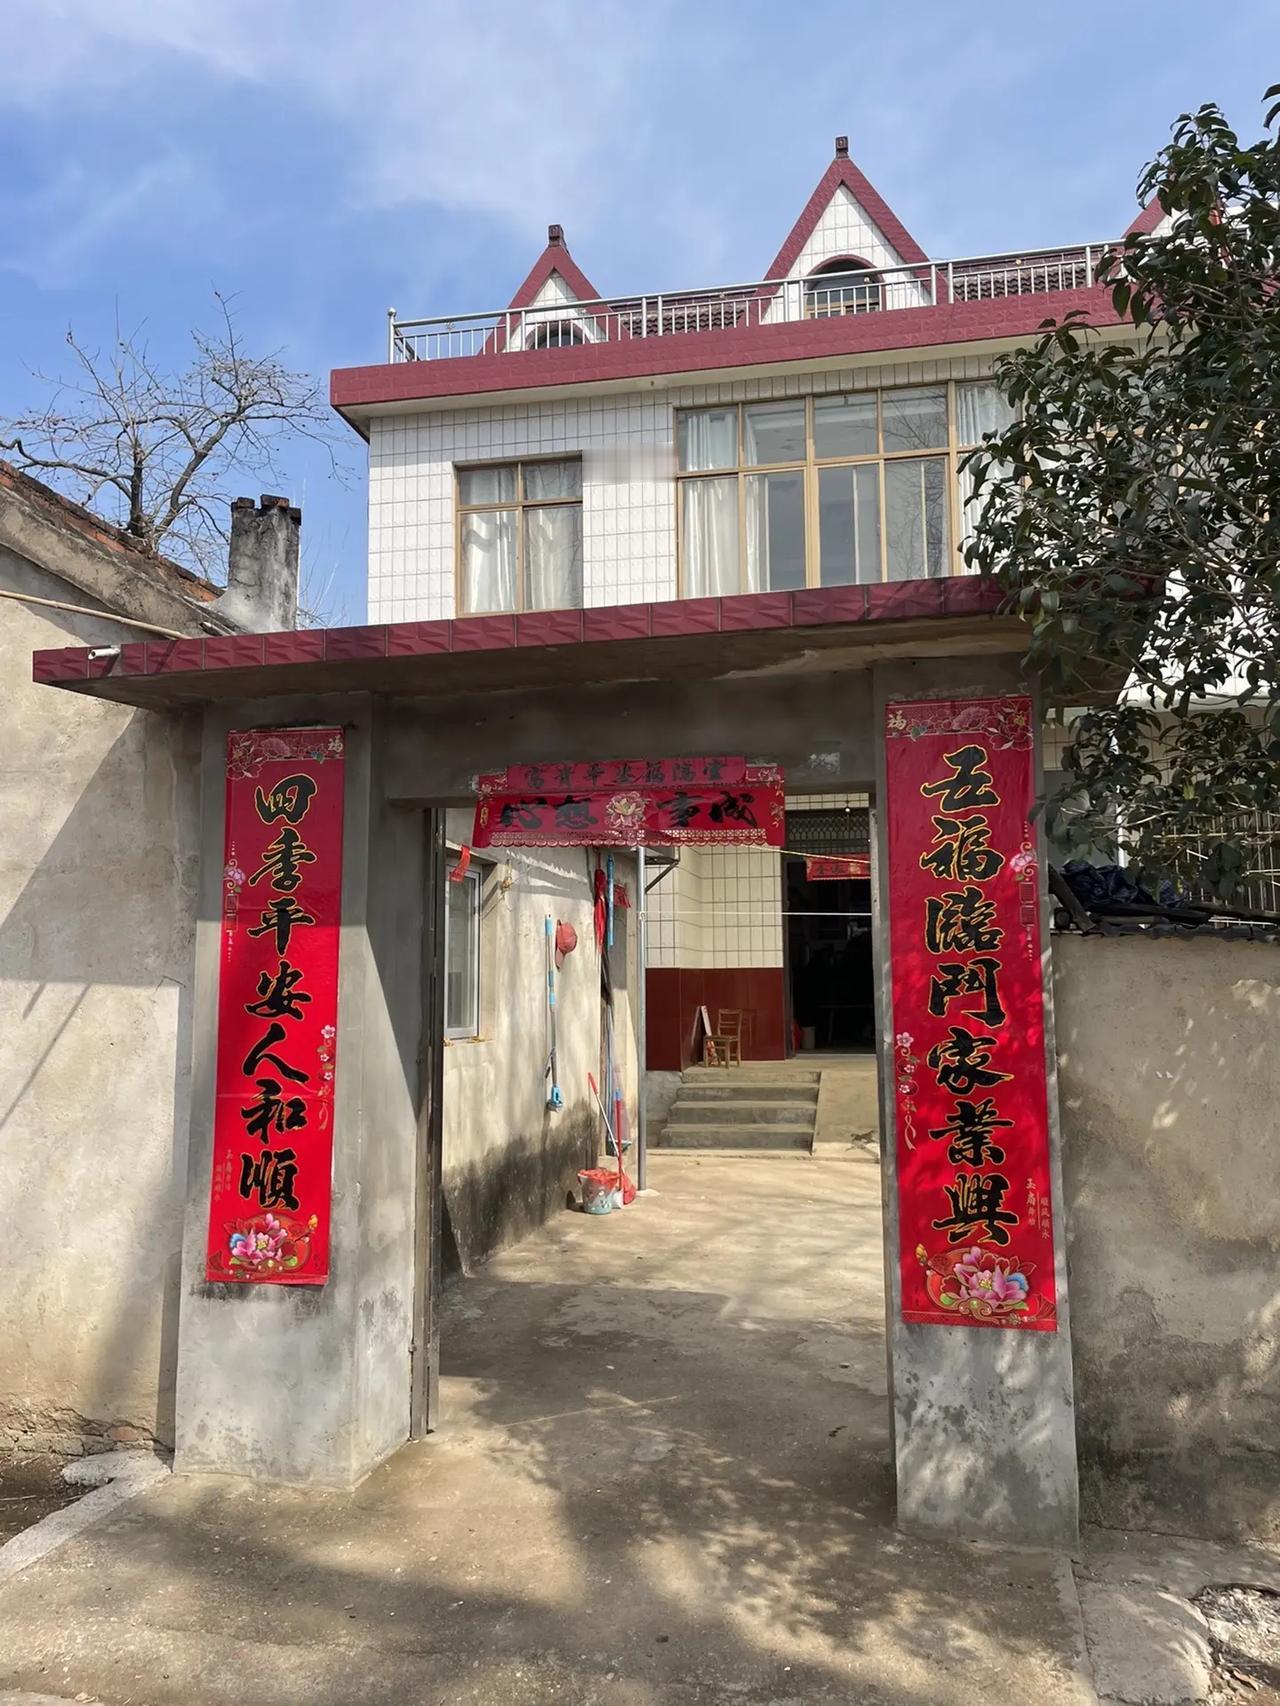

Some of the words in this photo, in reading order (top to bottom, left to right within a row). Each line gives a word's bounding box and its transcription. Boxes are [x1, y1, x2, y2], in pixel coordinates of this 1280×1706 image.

[239, 773, 318, 1211] 四季平安人和順
[919, 744, 1019, 1247] 五福臨門家業興
